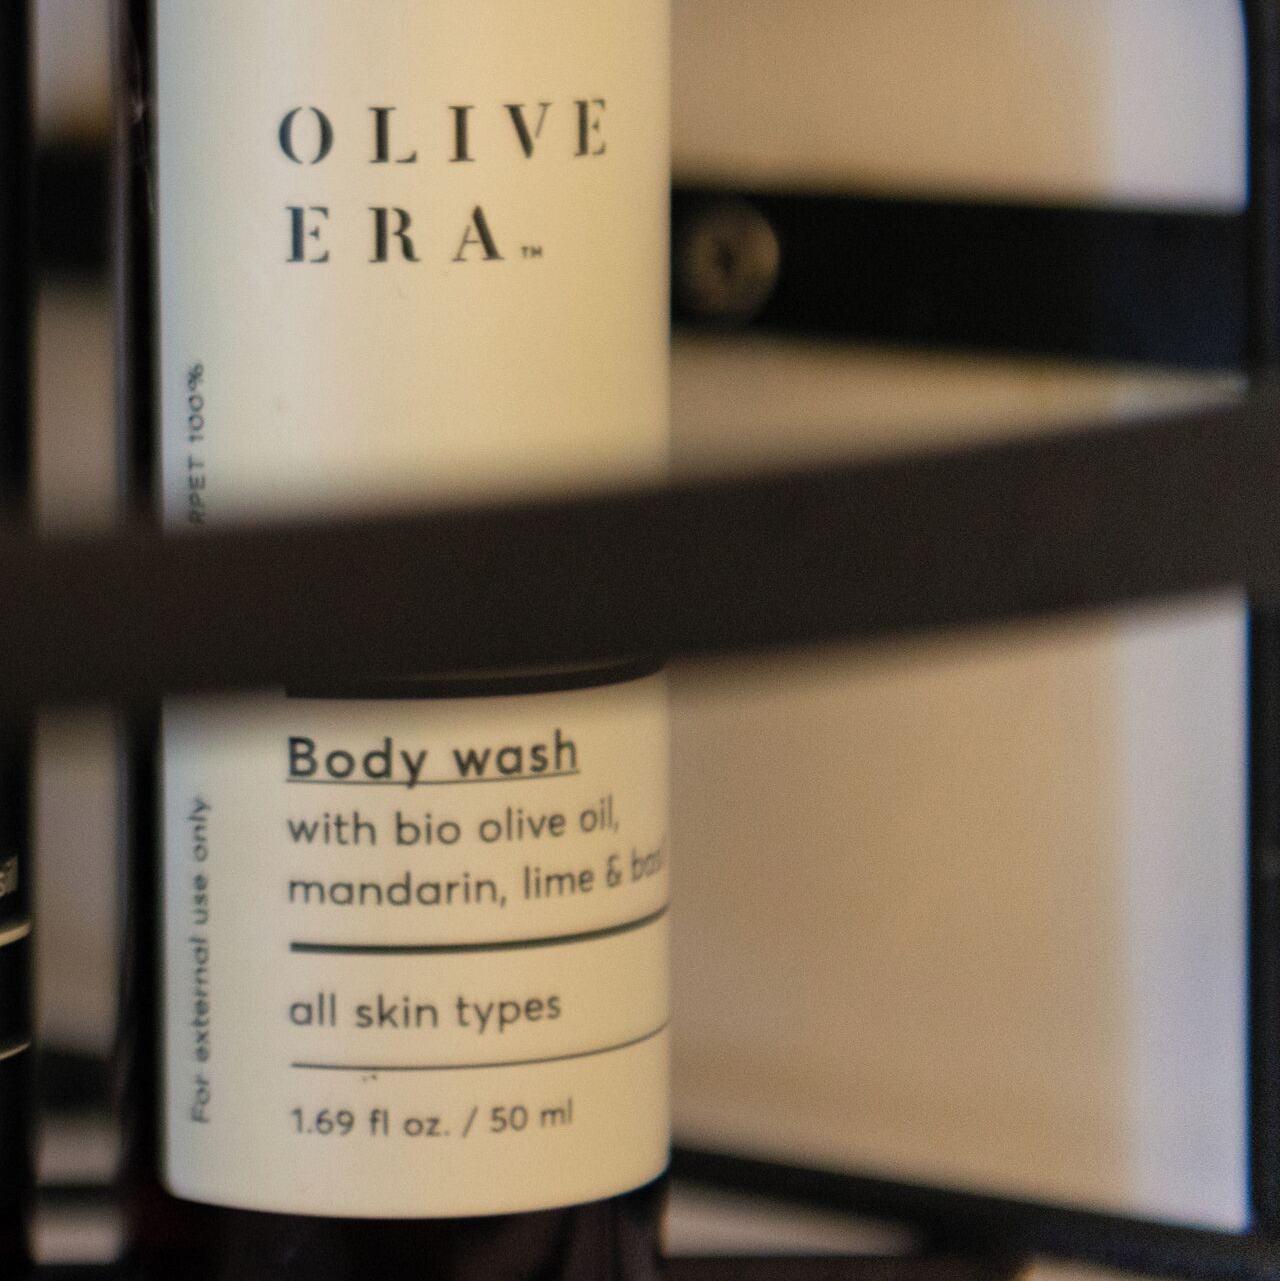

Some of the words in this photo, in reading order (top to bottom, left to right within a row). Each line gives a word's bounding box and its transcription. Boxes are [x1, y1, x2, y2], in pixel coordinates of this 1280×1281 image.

[278, 99, 606, 165] OLIVE
[189, 363, 204, 441] 100%
[287, 737, 428, 788] Body
[453, 729, 578, 778] wash
[187, 797, 212, 862] only
[287, 811, 376, 845] with
[395, 812, 461, 846] bio
[479, 808, 566, 843] olive
[579, 795, 619, 832] oil,
[192, 874, 208, 926] use
[289, 873, 508, 906] mandarin,
[523, 866, 593, 900] lime
[607, 854, 621, 888] &
[189, 937, 210, 1063] external
[290, 993, 336, 1026] all
[356, 995, 438, 1028] skin
[456, 993, 561, 1033] types
[192, 1078, 211, 1124] For
[293, 1109, 354, 1135] 1.69
[369, 1109, 388, 1136] fl
[404, 1116, 449, 1138] oz.
[462, 1108, 478, 1137] /
[490, 1106, 527, 1132] 50
[540, 1099, 572, 1127] ml
